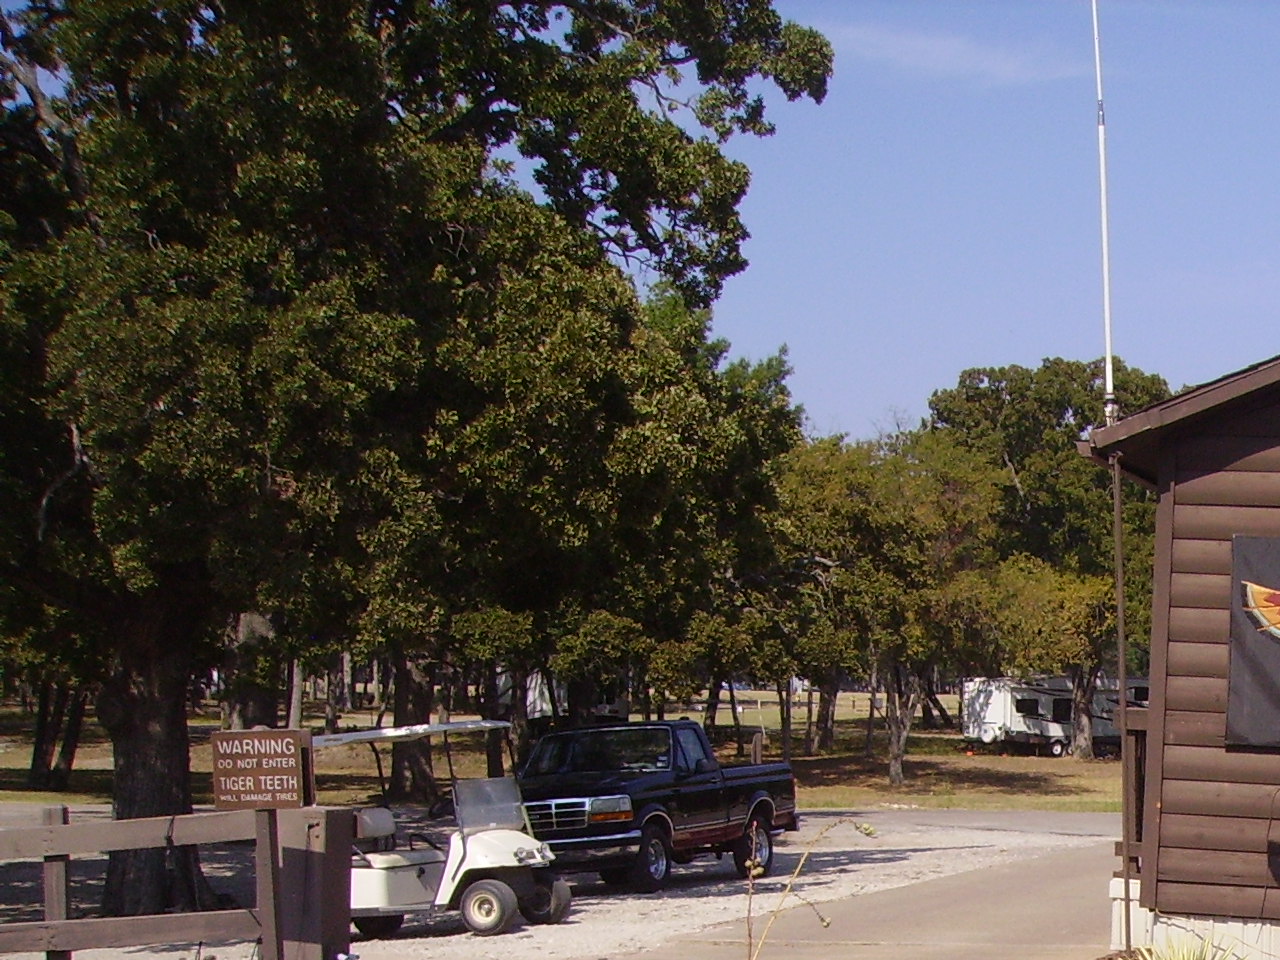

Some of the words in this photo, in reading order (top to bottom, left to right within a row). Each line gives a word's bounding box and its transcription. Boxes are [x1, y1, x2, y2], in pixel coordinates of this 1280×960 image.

[217, 738, 295, 755] WARNING
[217, 759, 233, 769] DO
[237, 758, 258, 769] NOT
[262, 757, 296, 768] ENTER
[219, 776, 255, 791] TIGER
[259, 775, 298, 790] TEETH
[219, 794, 238, 802] WILL
[240, 792, 273, 801] DAMAGE
[275, 792, 298, 801] TIRES
